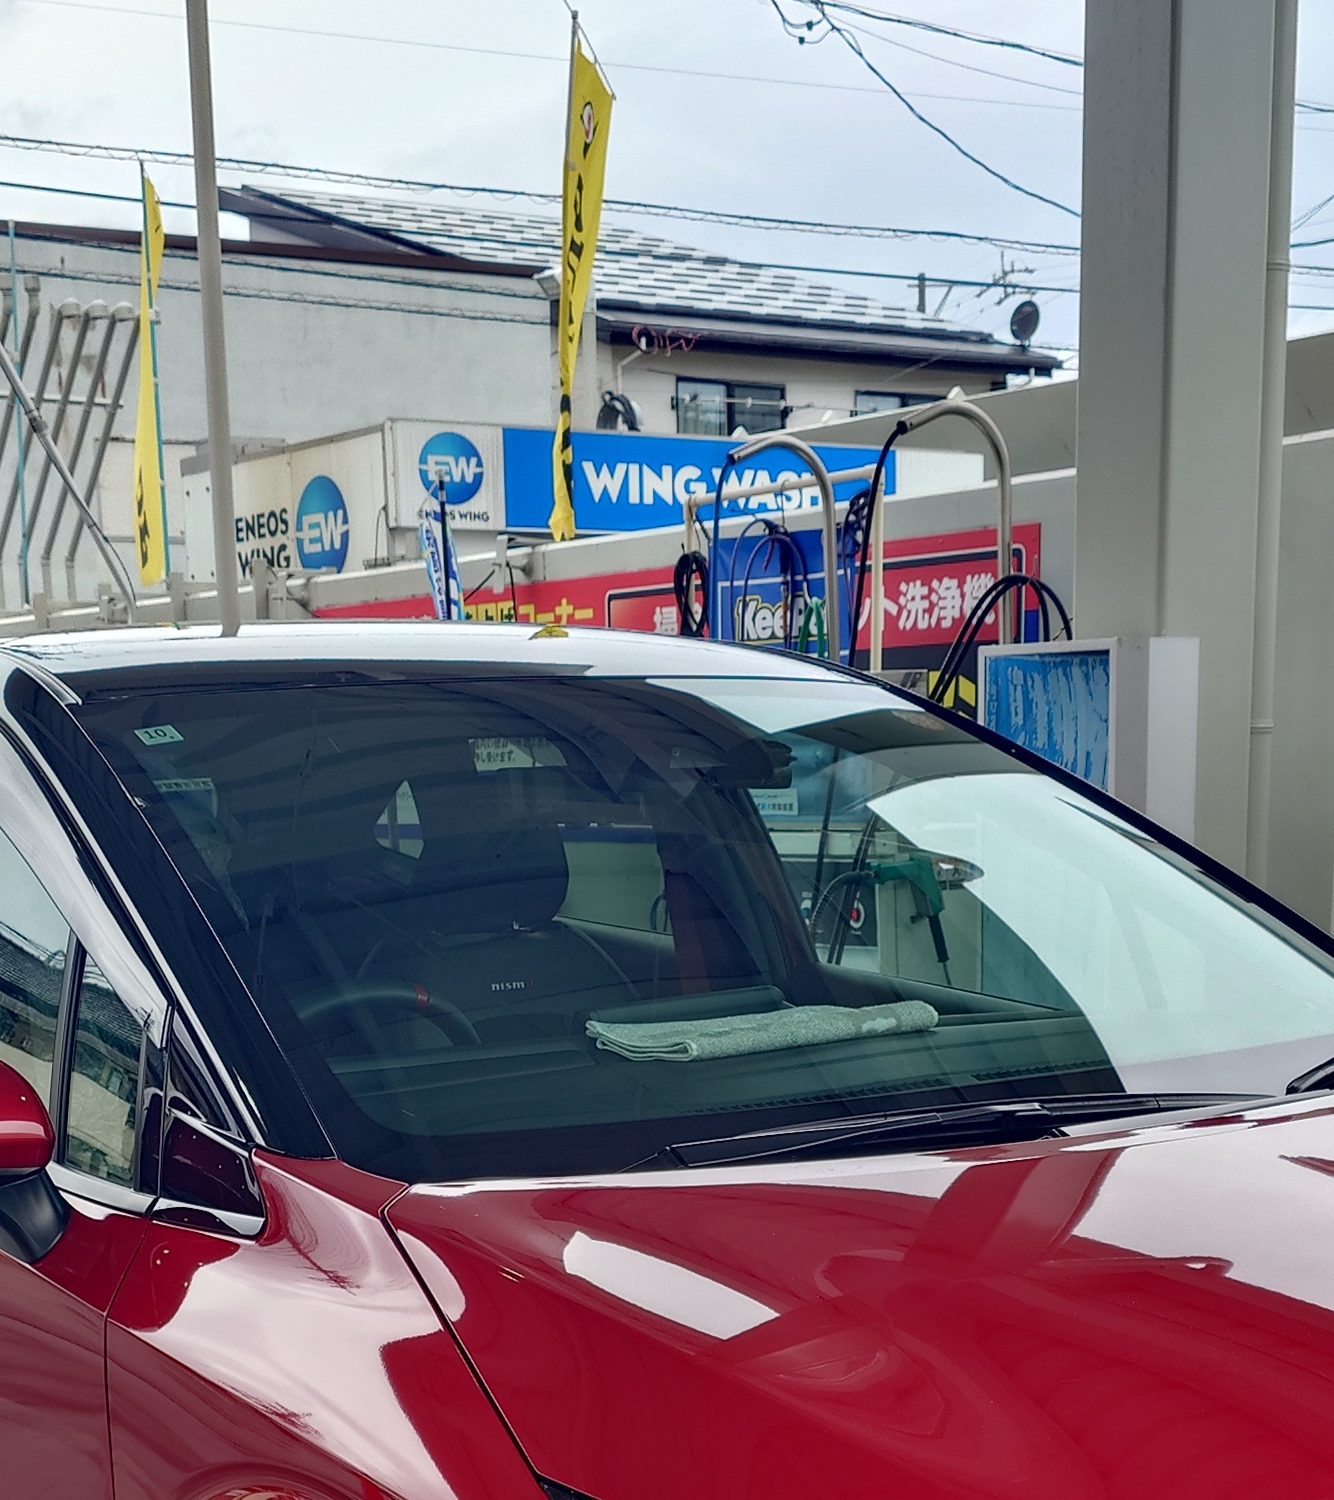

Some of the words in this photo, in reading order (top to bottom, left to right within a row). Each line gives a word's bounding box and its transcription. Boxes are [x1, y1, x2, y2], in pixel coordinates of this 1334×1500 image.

[582, 460, 708, 505] WING
[713, 466, 823, 510] WASH
[235, 507, 289, 543] ENEOS
[459, 510, 490, 521] WING
